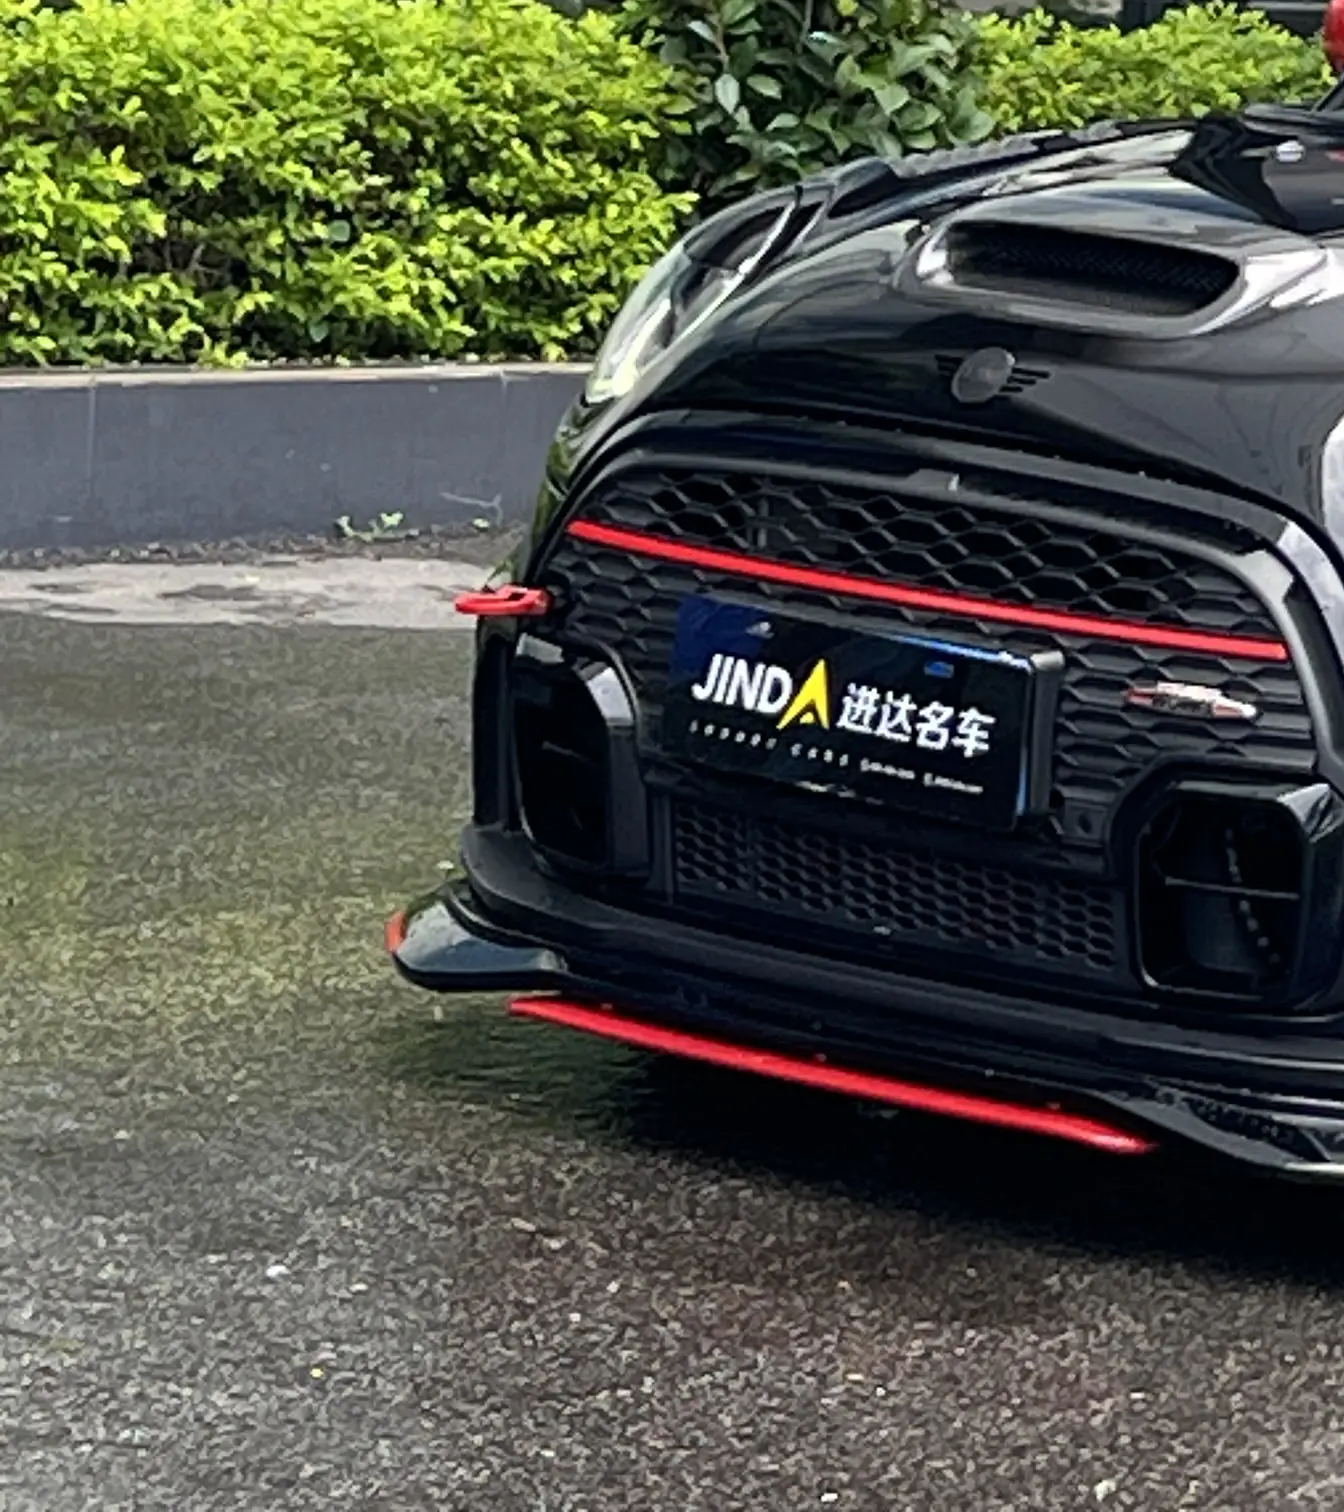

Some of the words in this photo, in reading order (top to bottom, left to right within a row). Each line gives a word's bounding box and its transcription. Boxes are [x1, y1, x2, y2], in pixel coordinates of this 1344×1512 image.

[691, 653, 829, 730] JINDA
[836, 682, 996, 758] 进达名车
